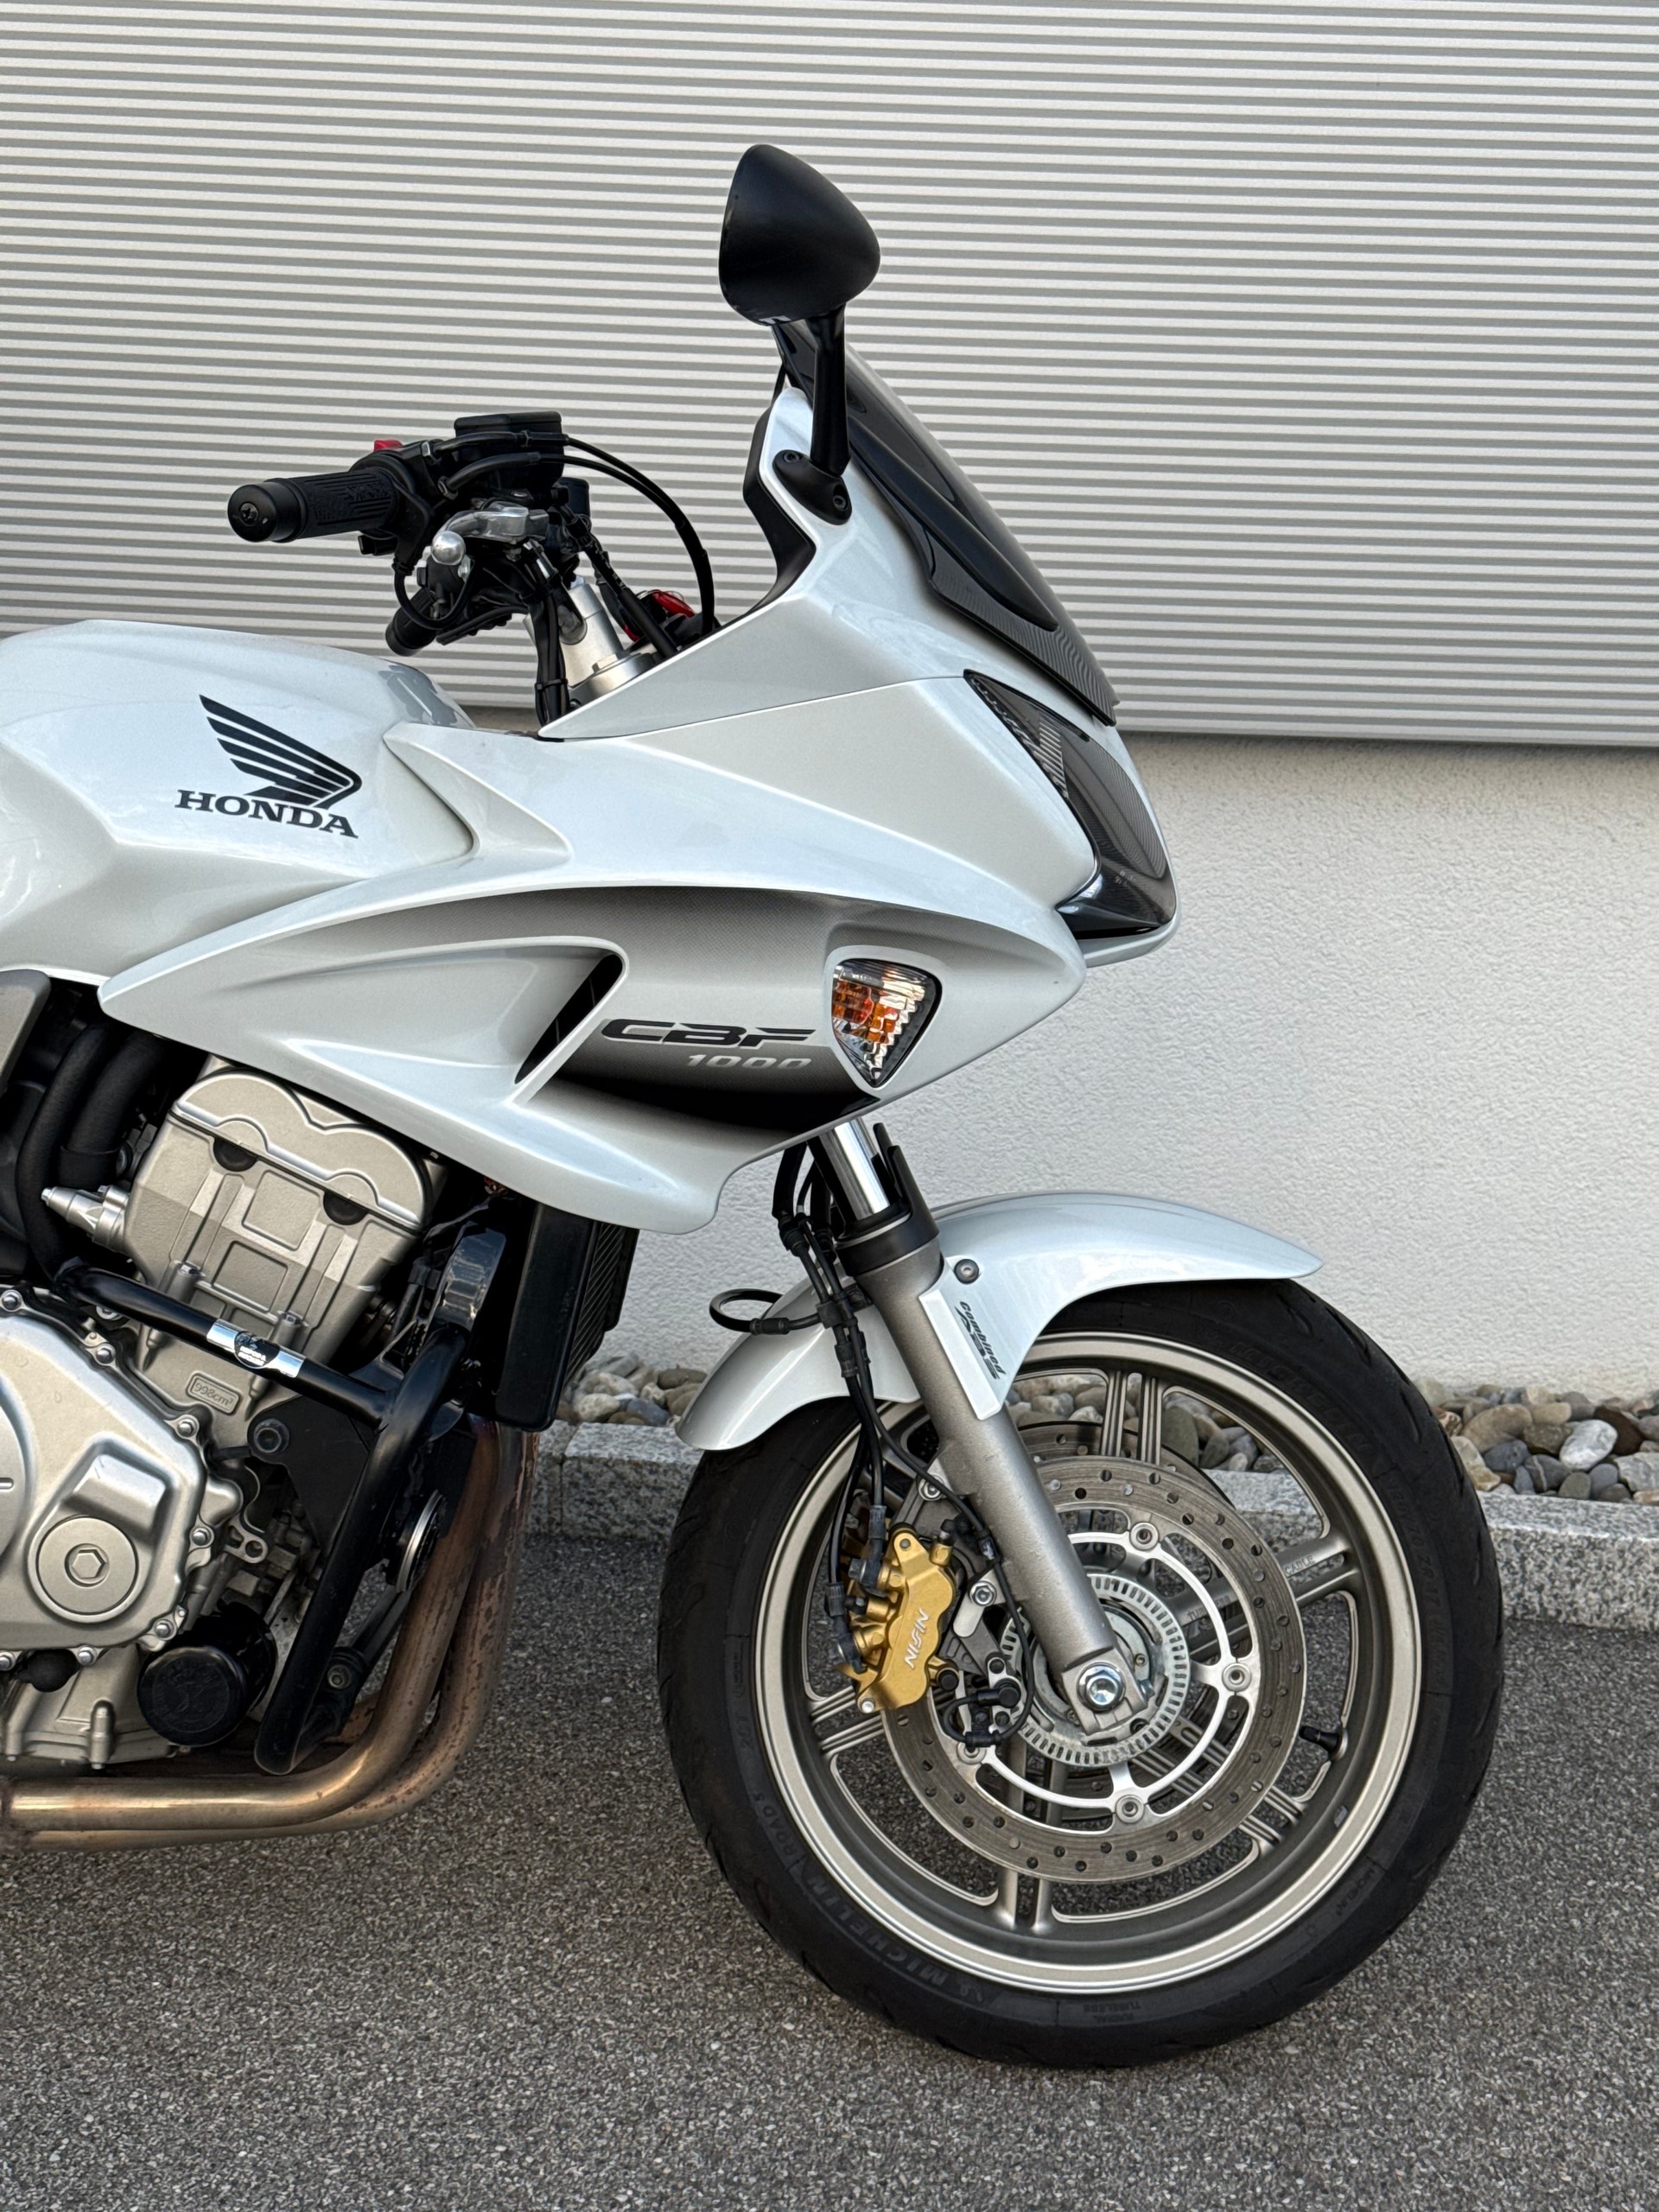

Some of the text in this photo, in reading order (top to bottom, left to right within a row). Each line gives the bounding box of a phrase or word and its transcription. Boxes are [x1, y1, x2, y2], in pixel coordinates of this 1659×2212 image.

[174, 789, 359, 839] HONDA
[601, 1018, 817, 1048] CBF
[688, 1053, 812, 1070] 1000
[959, 1300, 1007, 1376] Combined
[804, 1873, 949, 1987] MICHELIN
